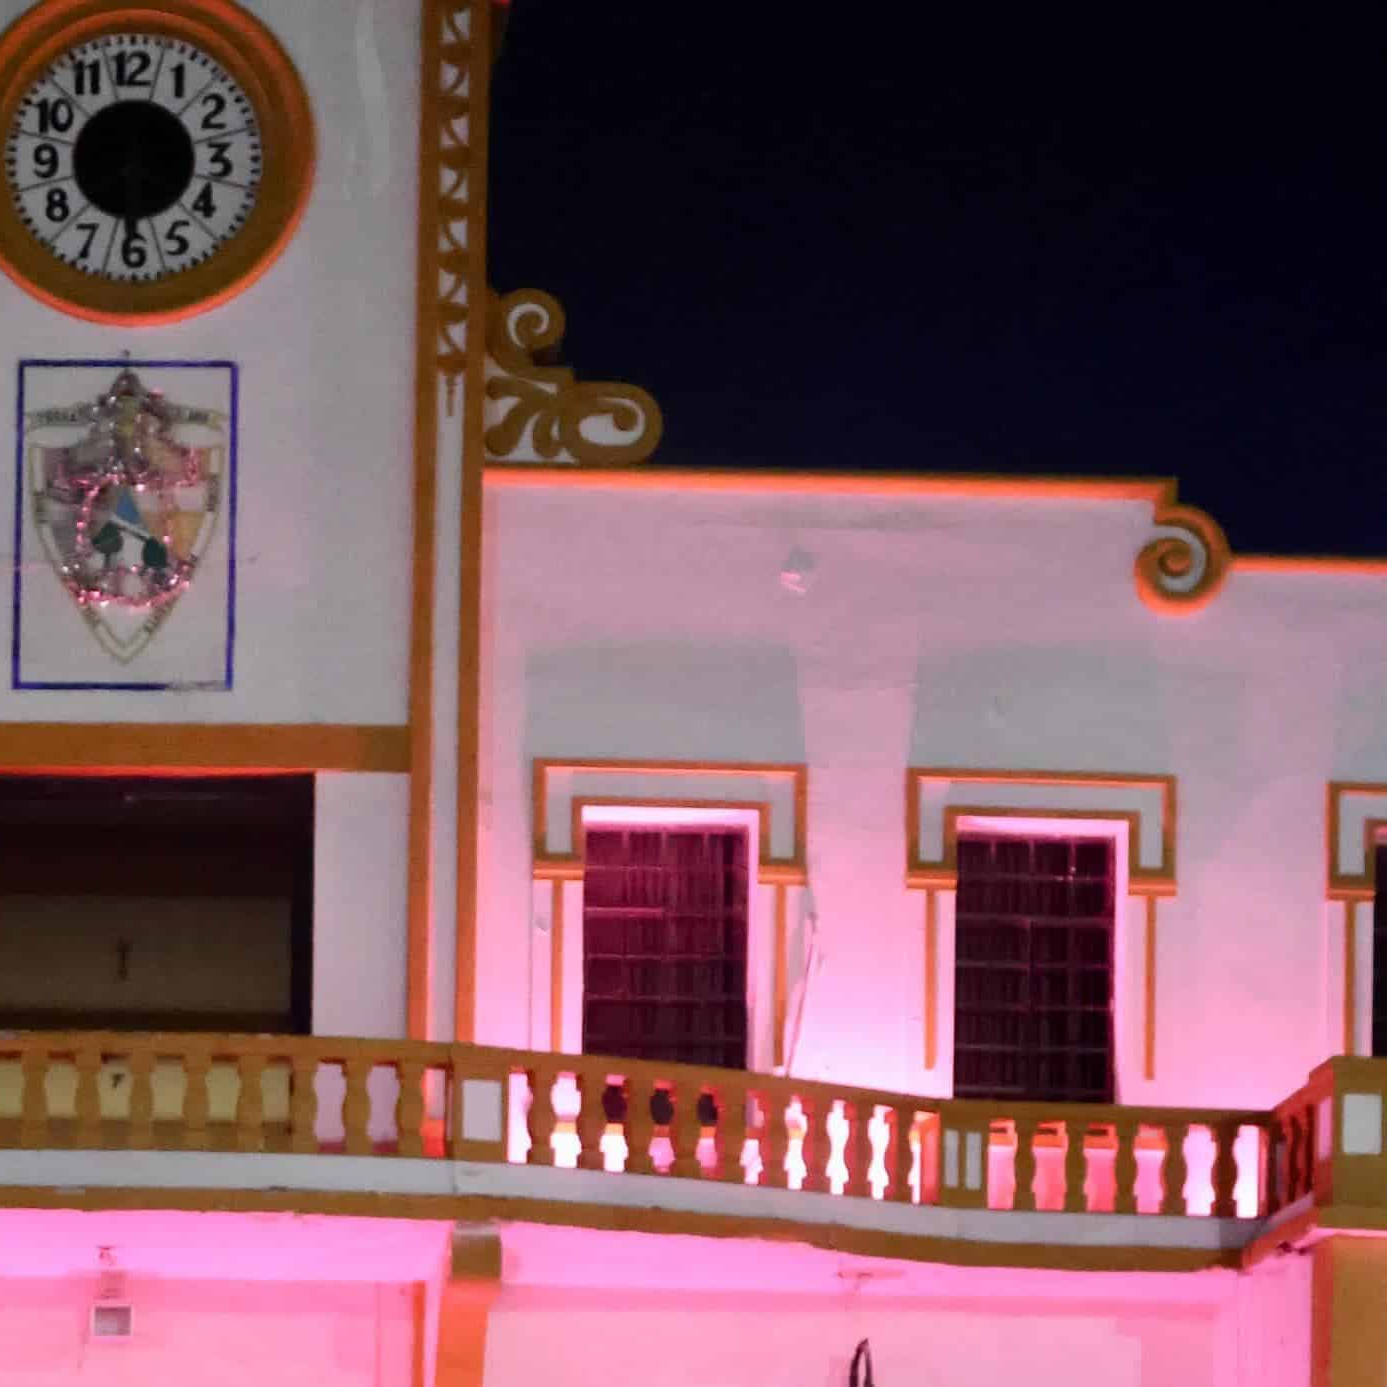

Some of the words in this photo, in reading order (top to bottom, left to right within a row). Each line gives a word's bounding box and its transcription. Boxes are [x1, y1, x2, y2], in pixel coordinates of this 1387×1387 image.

[72, 60, 101, 96] 11
[112, 50, 152, 87] 12
[171, 63, 185, 99] 1
[35, 97, 74, 134] 10
[201, 93, 226, 130] 2
[33, 142, 59, 179] 9
[207, 142, 233, 178] 3
[45, 187, 70, 223] 8
[191, 182, 217, 219] 4
[76, 223, 99, 259] 7
[121, 232, 147, 269] 6
[165, 220, 190, 256] 5
